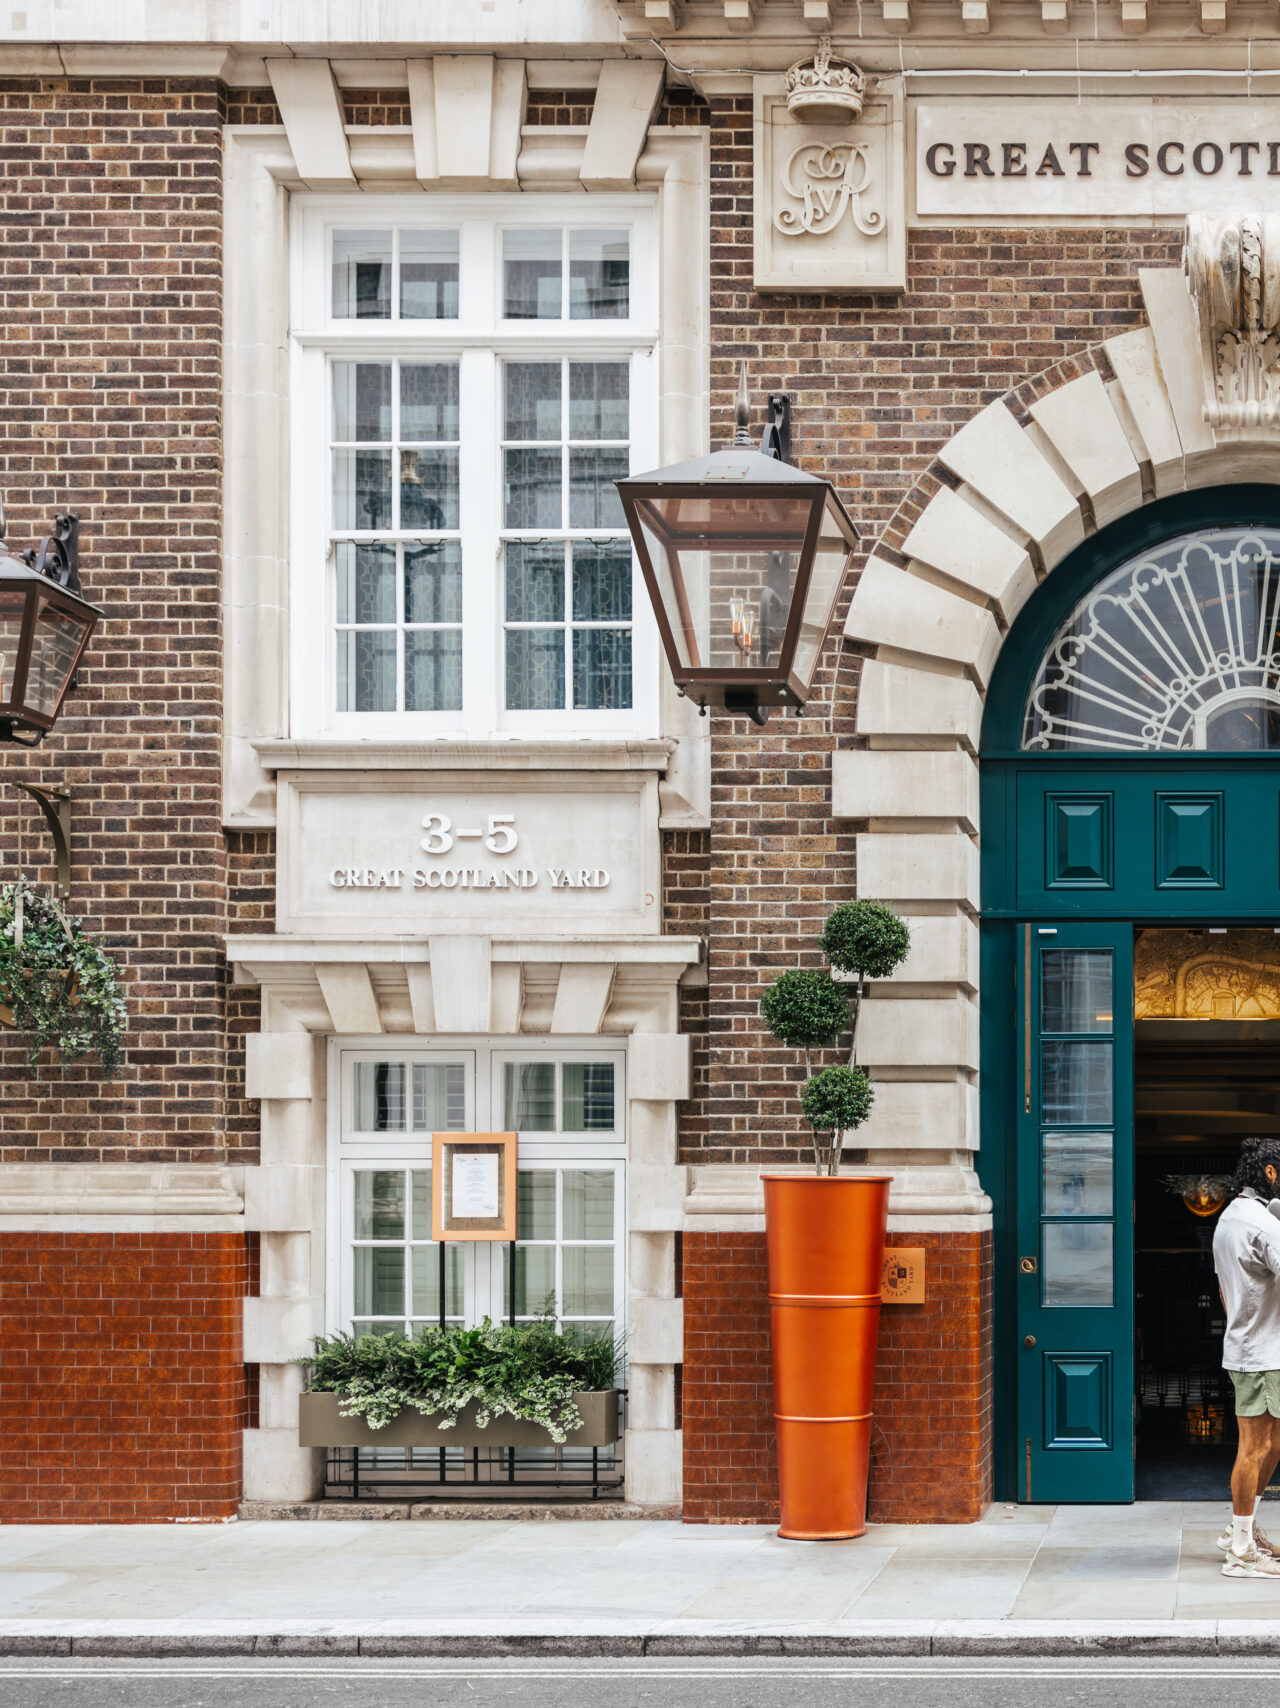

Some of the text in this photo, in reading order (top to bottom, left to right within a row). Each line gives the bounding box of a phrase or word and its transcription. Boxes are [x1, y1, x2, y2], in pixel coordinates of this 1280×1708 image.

[925, 141, 1099, 177] GREAT
[330, 868, 611, 888] GREAT SCOTLAND YARD
